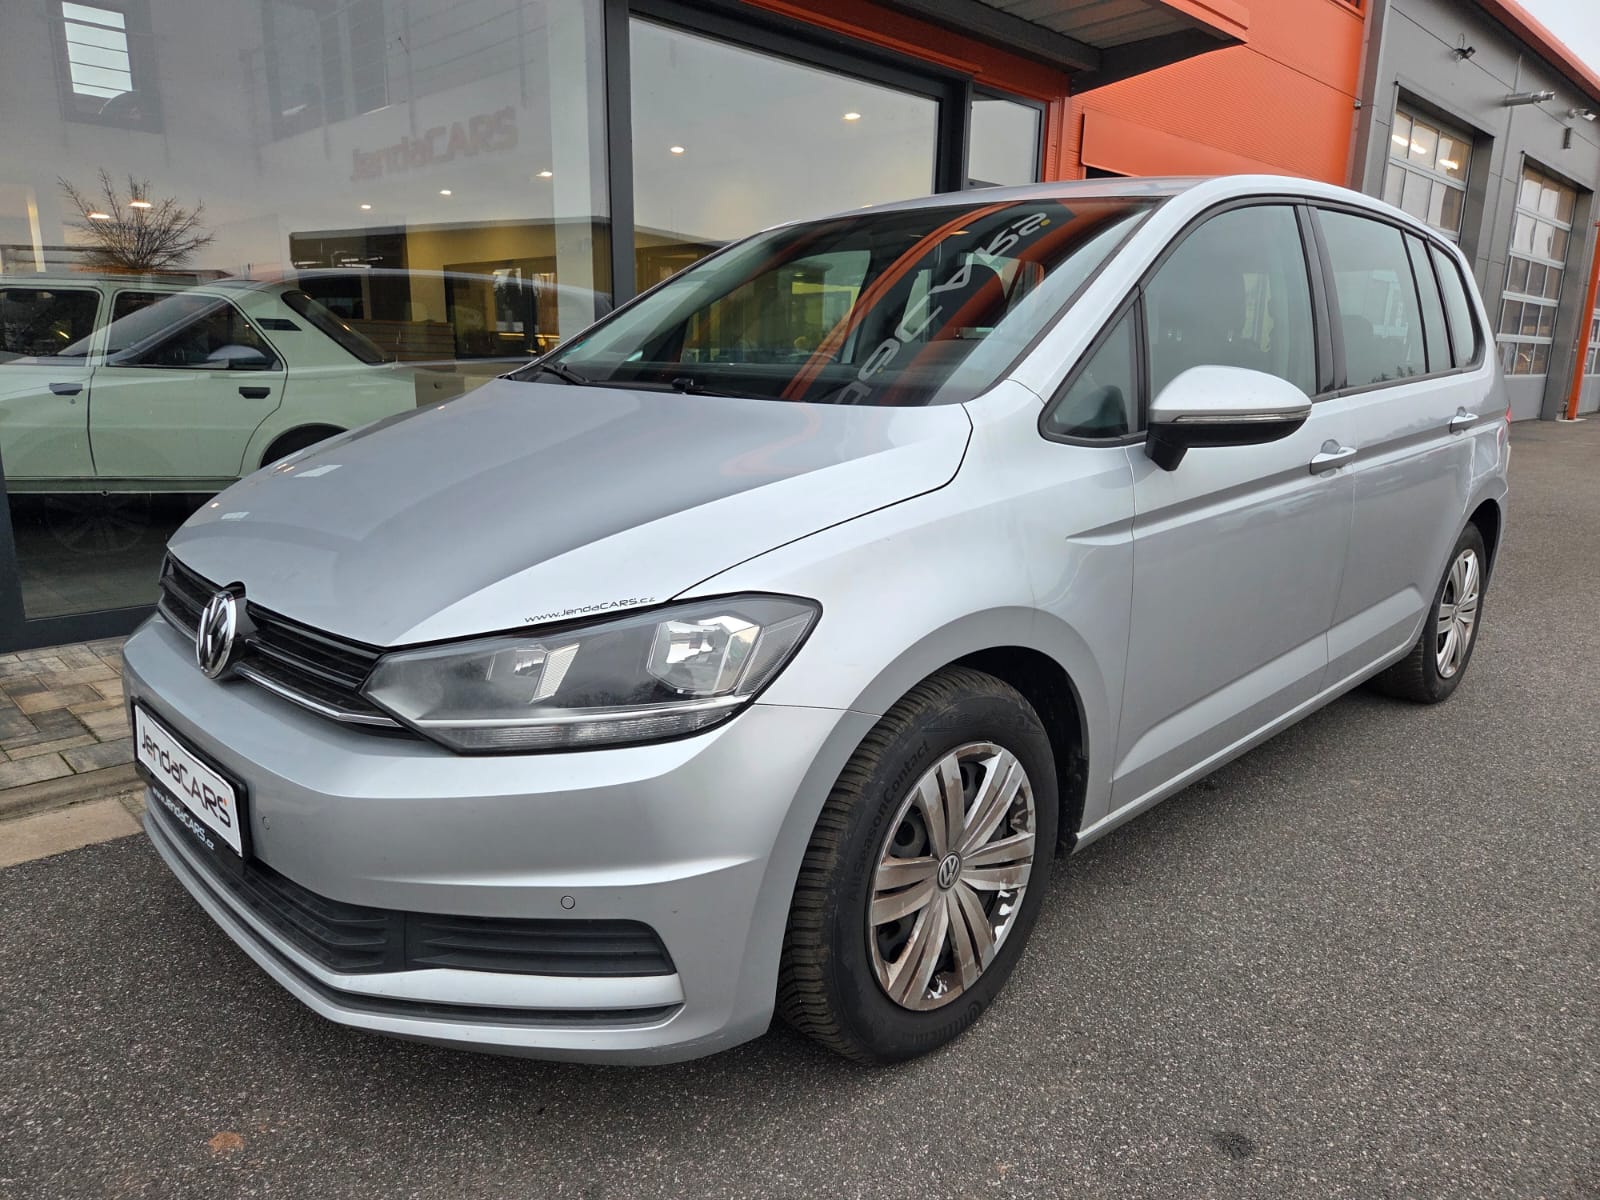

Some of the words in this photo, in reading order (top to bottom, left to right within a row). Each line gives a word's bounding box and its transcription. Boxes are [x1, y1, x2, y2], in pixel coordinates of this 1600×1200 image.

[524, 597, 656, 623] www.JendaCARS.cz
[142, 726, 231, 828] JendaCARS
[939, 855, 960, 888] VW
